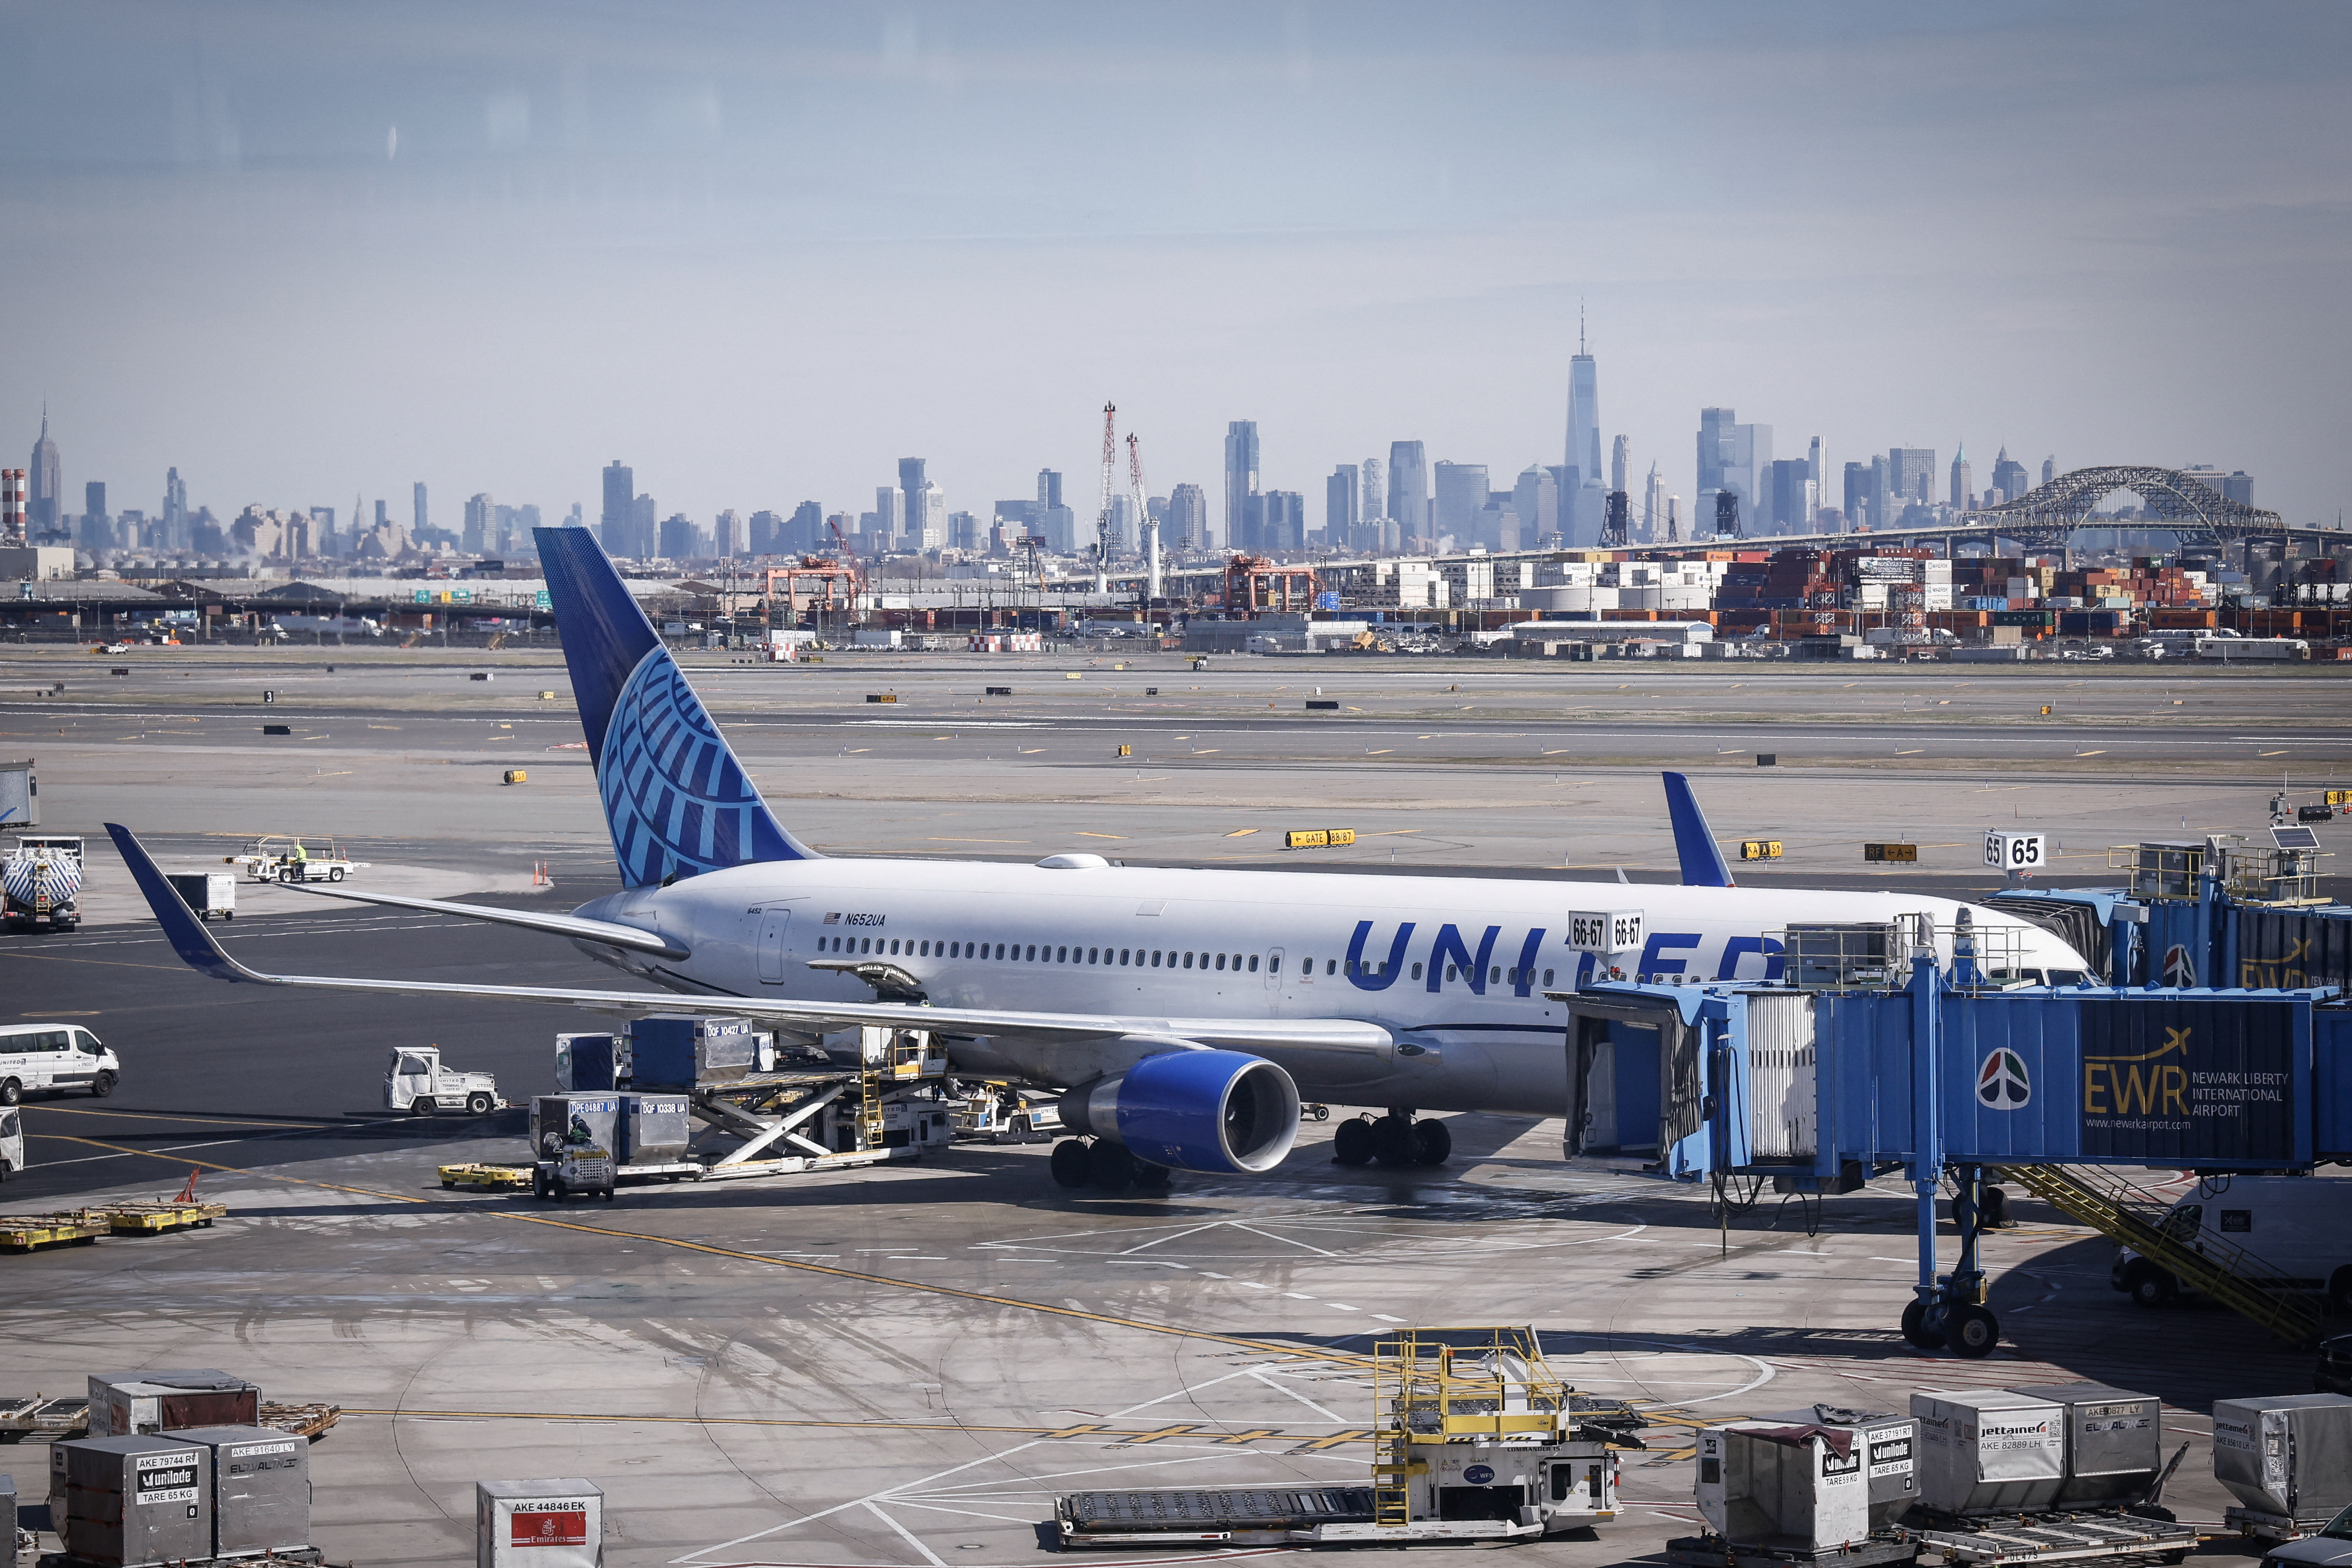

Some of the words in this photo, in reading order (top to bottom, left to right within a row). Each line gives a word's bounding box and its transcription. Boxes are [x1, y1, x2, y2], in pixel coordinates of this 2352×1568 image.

[267, 692, 272, 702] 3
[2339, 793, 2343, 801] B
[1306, 834, 1324, 843] GATE
[1331, 832, 1351, 842] 88/87
[1753, 845, 1758, 854] A
[1761, 844, 1768, 855] A
[1772, 845, 1777, 853] S
[1869, 847, 1881, 856] RF
[1897, 848, 1903, 857] A
[1986, 837, 2000, 864] 65
[2012, 838, 2038, 864] 65
[844, 913, 886, 927] N652UA
[1573, 918, 1603, 946] 66-67
[1615, 917, 1640, 946] 66-67
[708, 1027, 719, 1037] DQF
[721, 1025, 739, 1036] 10427
[740, 1024, 749, 1034] UA
[2193, 1071, 2240, 1084] NEWARK
[2244, 1072, 2289, 1085] LIBERTY
[2084, 1063, 2190, 1115] EWR
[2193, 1088, 2283, 1101] INTERNATIONAL
[572, 1103, 584, 1114] DPE
[585, 1102, 604, 1113] 04887
[607, 1102, 616, 1112] UA
[643, 1104, 655, 1114] DQF
[657, 1104, 676, 1113] 10338
[677, 1103, 685, 1113] UA
[2193, 1105, 2240, 1117] AIRPORT
[2086, 1118, 2191, 1131] www.newarkairport.com
[2129, 1405, 2140, 1414] LY
[1913, 1415, 1949, 1429] ttainer
[2085, 1423, 2101, 1432] EL
[2111, 1421, 2126, 1430] AL
[2216, 1422, 2248, 1434] jettainer
[1871, 1432, 1883, 1442] AKE
[1884, 1428, 1902, 1439] 37191
[1902, 1427, 1911, 1436] R7
[1980, 1421, 2047, 1438] jettainer
[1939, 1434, 1947, 1444] LH
[2216, 1436, 2227, 1445] AKE
[2227, 1438, 2242, 1448] 85610
[2243, 1441, 2250, 1450] LH
[232, 1447, 251, 1456] AKE
[254, 1445, 280, 1454] 91640
[1882, 1442, 1908, 1459] unilode
[1980, 1442, 2000, 1450] AKE
[2002, 1441, 2027, 1449] 82889
[139, 1458, 157, 1468] AKE
[160, 1456, 183, 1466] 79744
[230, 1464, 246, 1473] EL
[257, 1462, 272, 1470] AL
[1874, 1466, 1890, 1475] TARE
[1891, 1464, 1899, 1472] 65
[1900, 1462, 1909, 1471] KG
[155, 1468, 191, 1486] unilode
[1826, 1477, 1843, 1486] TARE
[1843, 1475, 1849, 1484] 59
[1850, 1473, 1857, 1482] KG
[143, 1493, 166, 1502] TARE
[168, 1491, 177, 1500] 65
[514, 1503, 535, 1512] AKE
[537, 1502, 569, 1511] 44846
[571, 1501, 586, 1510] EK
[2114, 1543, 2130, 1552] WFS
[2010, 1551, 2038, 1562] DL475
